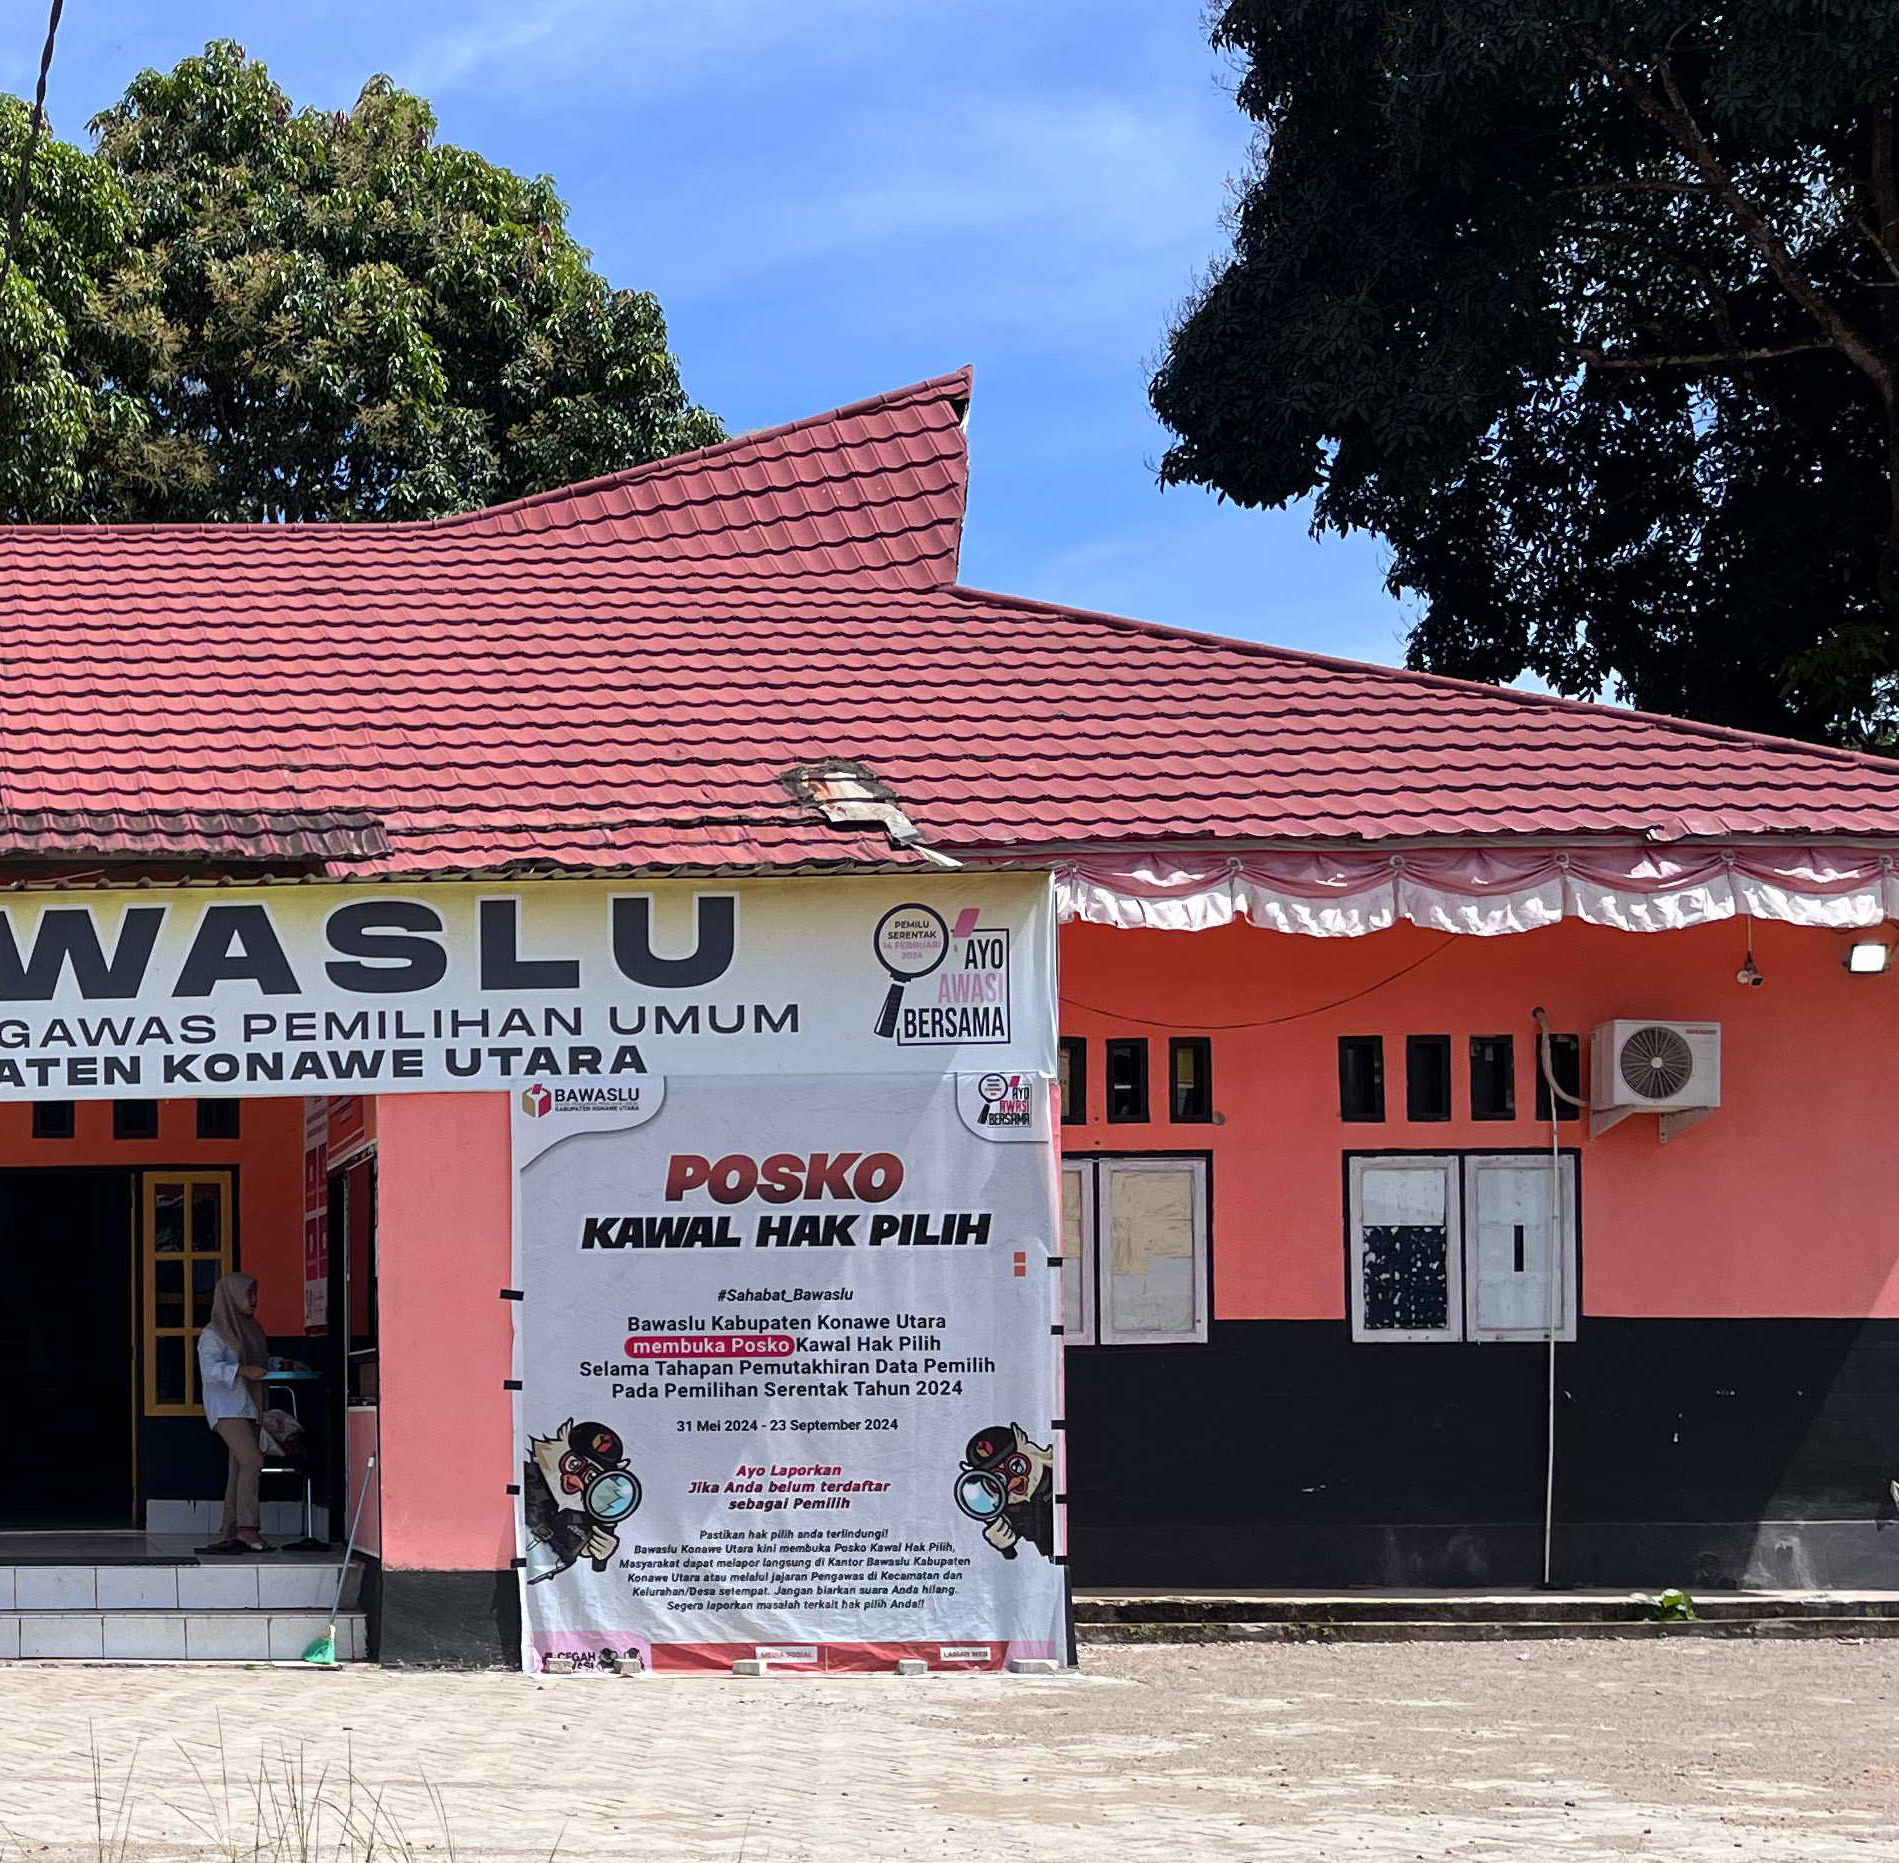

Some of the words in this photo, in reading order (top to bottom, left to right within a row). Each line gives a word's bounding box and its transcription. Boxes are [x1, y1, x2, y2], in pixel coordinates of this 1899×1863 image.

[894, 920, 930, 929] PEMILU
[887, 931, 937, 940] SERENTAK
[964, 938, 1004, 970] AYO
[937, 972, 1004, 1004] AWASI
[243, 1007, 581, 1043] PEMILIHAN
[609, 1003, 798, 1035] UMUM
[903, 1006, 1005, 1039] BERSAMA
[163, 1048, 423, 1083] KONAWE
[445, 1045, 647, 1077] UTARA
[554, 1087, 639, 1104] BAWASLU
[1012, 1086, 1030, 1101] AYO
[665, 1152, 903, 1205] POSKO
[581, 1215, 741, 1249] KAWAL
[755, 1214, 860, 1247] HAK
[868, 1212, 991, 1246] PILIH
[717, 1287, 853, 1303] #Sahabat_Bawaslu
[628, 1315, 705, 1331] Bawaslu
[711, 1314, 811, 1334] Kabupaten
[817, 1314, 890, 1330] Konawe
[896, 1313, 945, 1329] Utara
[633, 1337, 725, 1354] membuka
[731, 1336, 790, 1353] Posko
[796, 1335, 850, 1352] Kawal
[857, 1335, 893, 1351] Hak
[899, 1334, 940, 1351] Pilih
[579, 1360, 648, 1377] Selama
[654, 1359, 733, 1379] Tahapan
[739, 1358, 869, 1375] Pemutakhiran
[875, 1358, 917, 1374] Data
[924, 1356, 995, 1373] Pemilih
[612, 1382, 658, 1398] Pada
[664, 1381, 758, 1398] Pemilihan
[764, 1380, 848, 1397] Serentak
[853, 1379, 909, 1396] Tahun
[916, 1379, 962, 1395] 2024
[676, 1420, 691, 1432] 31
[696, 1419, 720, 1432] Mei
[724, 1419, 757, 1432] 2024
[769, 1419, 786, 1431] 23
[789, 1418, 861, 1434] September
[864, 1418, 898, 1430] 2024
[735, 1465, 765, 1479] Ayo
[770, 1463, 841, 1479] Laporkan
[688, 1481, 719, 1493] Jika
[723, 1480, 763, 1493] Anda
[768, 1480, 815, 1493] belum
[820, 1480, 891, 1492] terdaftar
[728, 1497, 789, 1512] sebagai
[793, 1496, 850, 1509] Pemilih
[699, 1529, 745, 1539] Pastikan
[748, 1529, 768, 1539] hak
[770, 1529, 793, 1541] pilih
[797, 1528, 823, 1539] anda
[826, 1528, 888, 1540] terlindungi!
[633, 1543, 677, 1554] Bawaslu
[680, 1544, 722, 1554] Konawe
[725, 1543, 753, 1553] Utara
[756, 1543, 776, 1553] kini
[778, 1542, 830, 1553] membuka
[834, 1542, 866, 1553] Posko
[869, 1542, 902, 1552] Kawal
[904, 1542, 925, 1552] Hak
[928, 1541, 955, 1554] Pilih,
[618, 1558, 680, 1571] Masyarakat
[682, 1557, 713, 1570] dapat
[716, 1557, 760, 1570] melapor
[762, 1557, 811, 1569] langsung
[814, 1557, 825, 1567] di
[827, 1557, 864, 1567] Kantor
[866, 1556, 910, 1567] Bawaslu
[913, 1556, 970, 1568] Kabupaten
[627, 1572, 668, 1583] Konawe
[671, 1572, 700, 1582] Utara
[702, 1573, 726, 1582] atau
[729, 1571, 768, 1582] melalui
[769, 1571, 807, 1584] jajaran
[810, 1571, 864, 1583] Pengawas
[867, 1571, 877, 1580] di
[880, 1570, 939, 1581] Kecamatan
[942, 1570, 962, 1580] dan
[631, 1586, 715, 1596] Kelurahan/Desa
[718, 1586, 770, 1598] setempat.
[773, 1585, 813, 1598] Jangan
[816, 1584, 856, 1595] biarkan
[859, 1587, 888, 1595] suara
[891, 1584, 918, 1595] Anda
[921, 1583, 958, 1597] hilang.
[666, 1600, 703, 1612] Segera
[706, 1600, 753, 1612] laporkan
[756, 1599, 800, 1610] masalah
[803, 1599, 838, 1609] terkait
[841, 1599, 860, 1609] hak
[863, 1598, 887, 1611] pilih
[889, 1598, 924, 1608] Anda!!
